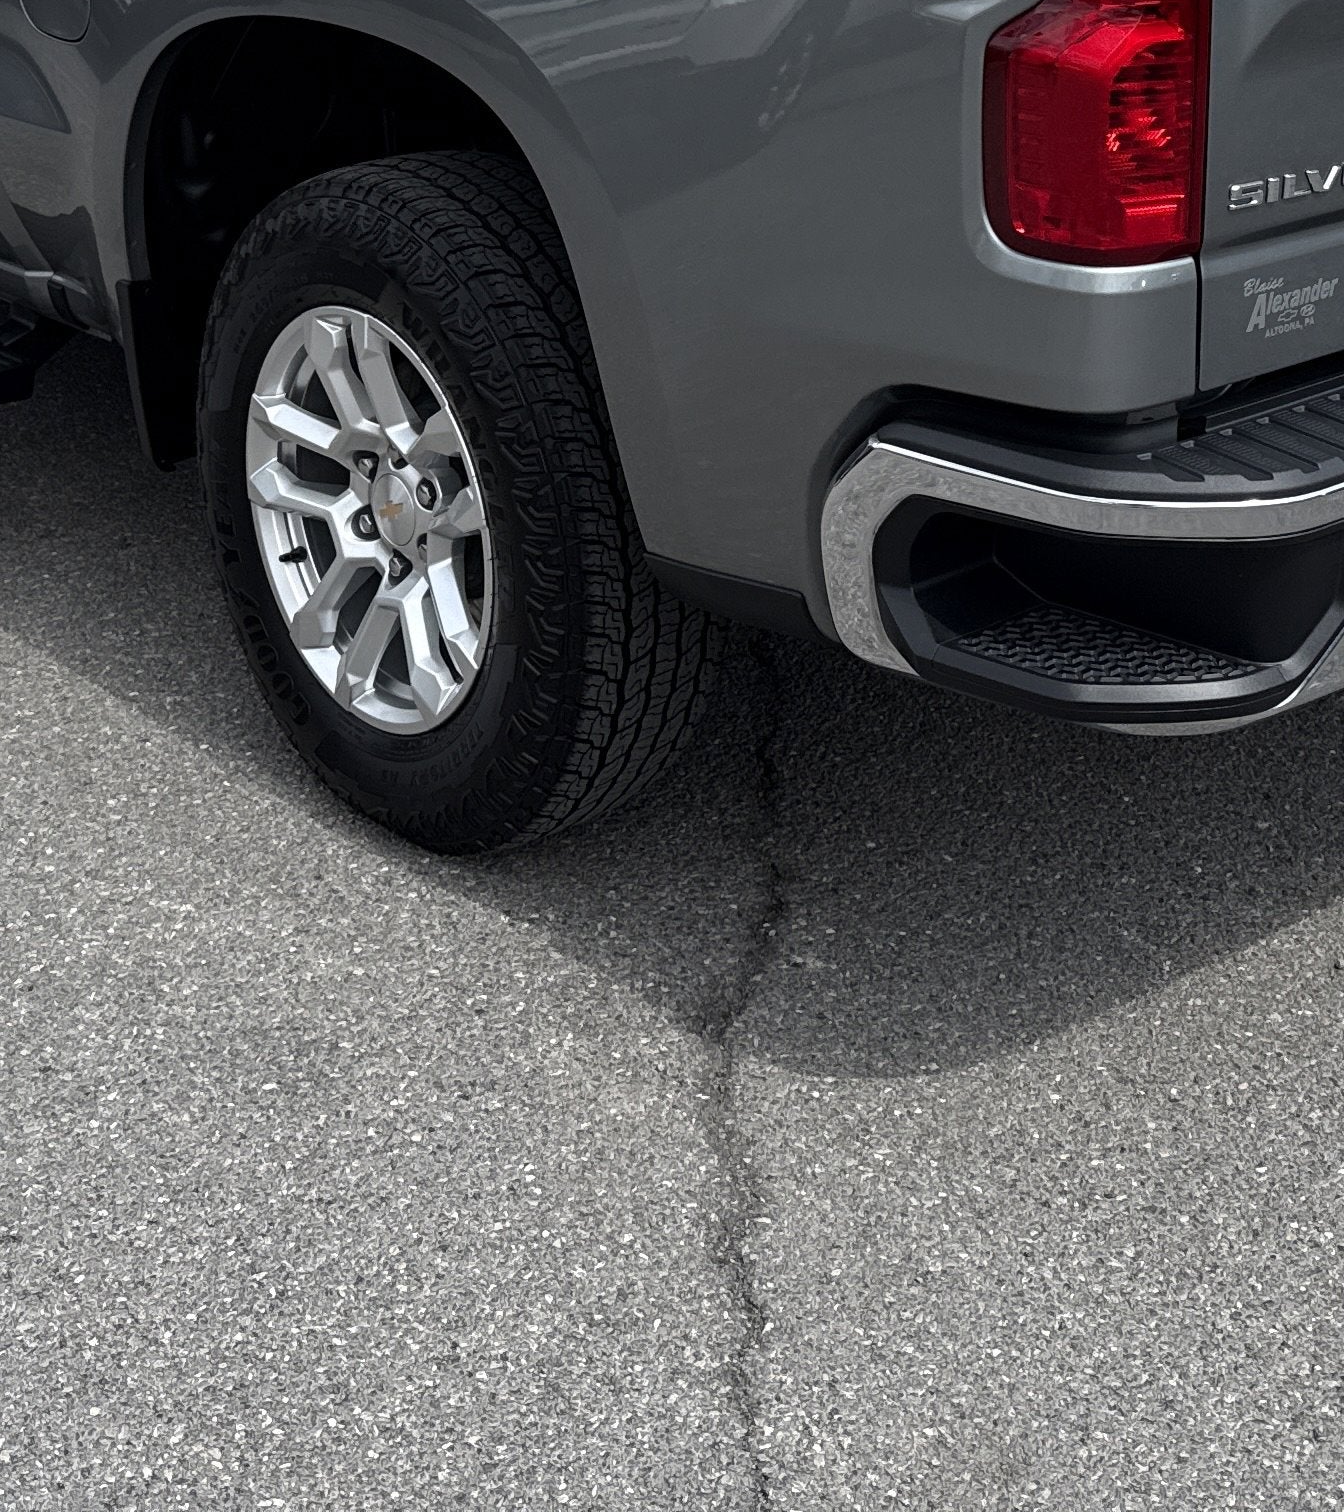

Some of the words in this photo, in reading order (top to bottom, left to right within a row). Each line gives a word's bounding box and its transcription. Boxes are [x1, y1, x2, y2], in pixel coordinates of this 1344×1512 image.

[1243, 277, 1284, 297] Blaise
[1246, 277, 1339, 333] Alexander
[1304, 316, 1315, 327] PA
